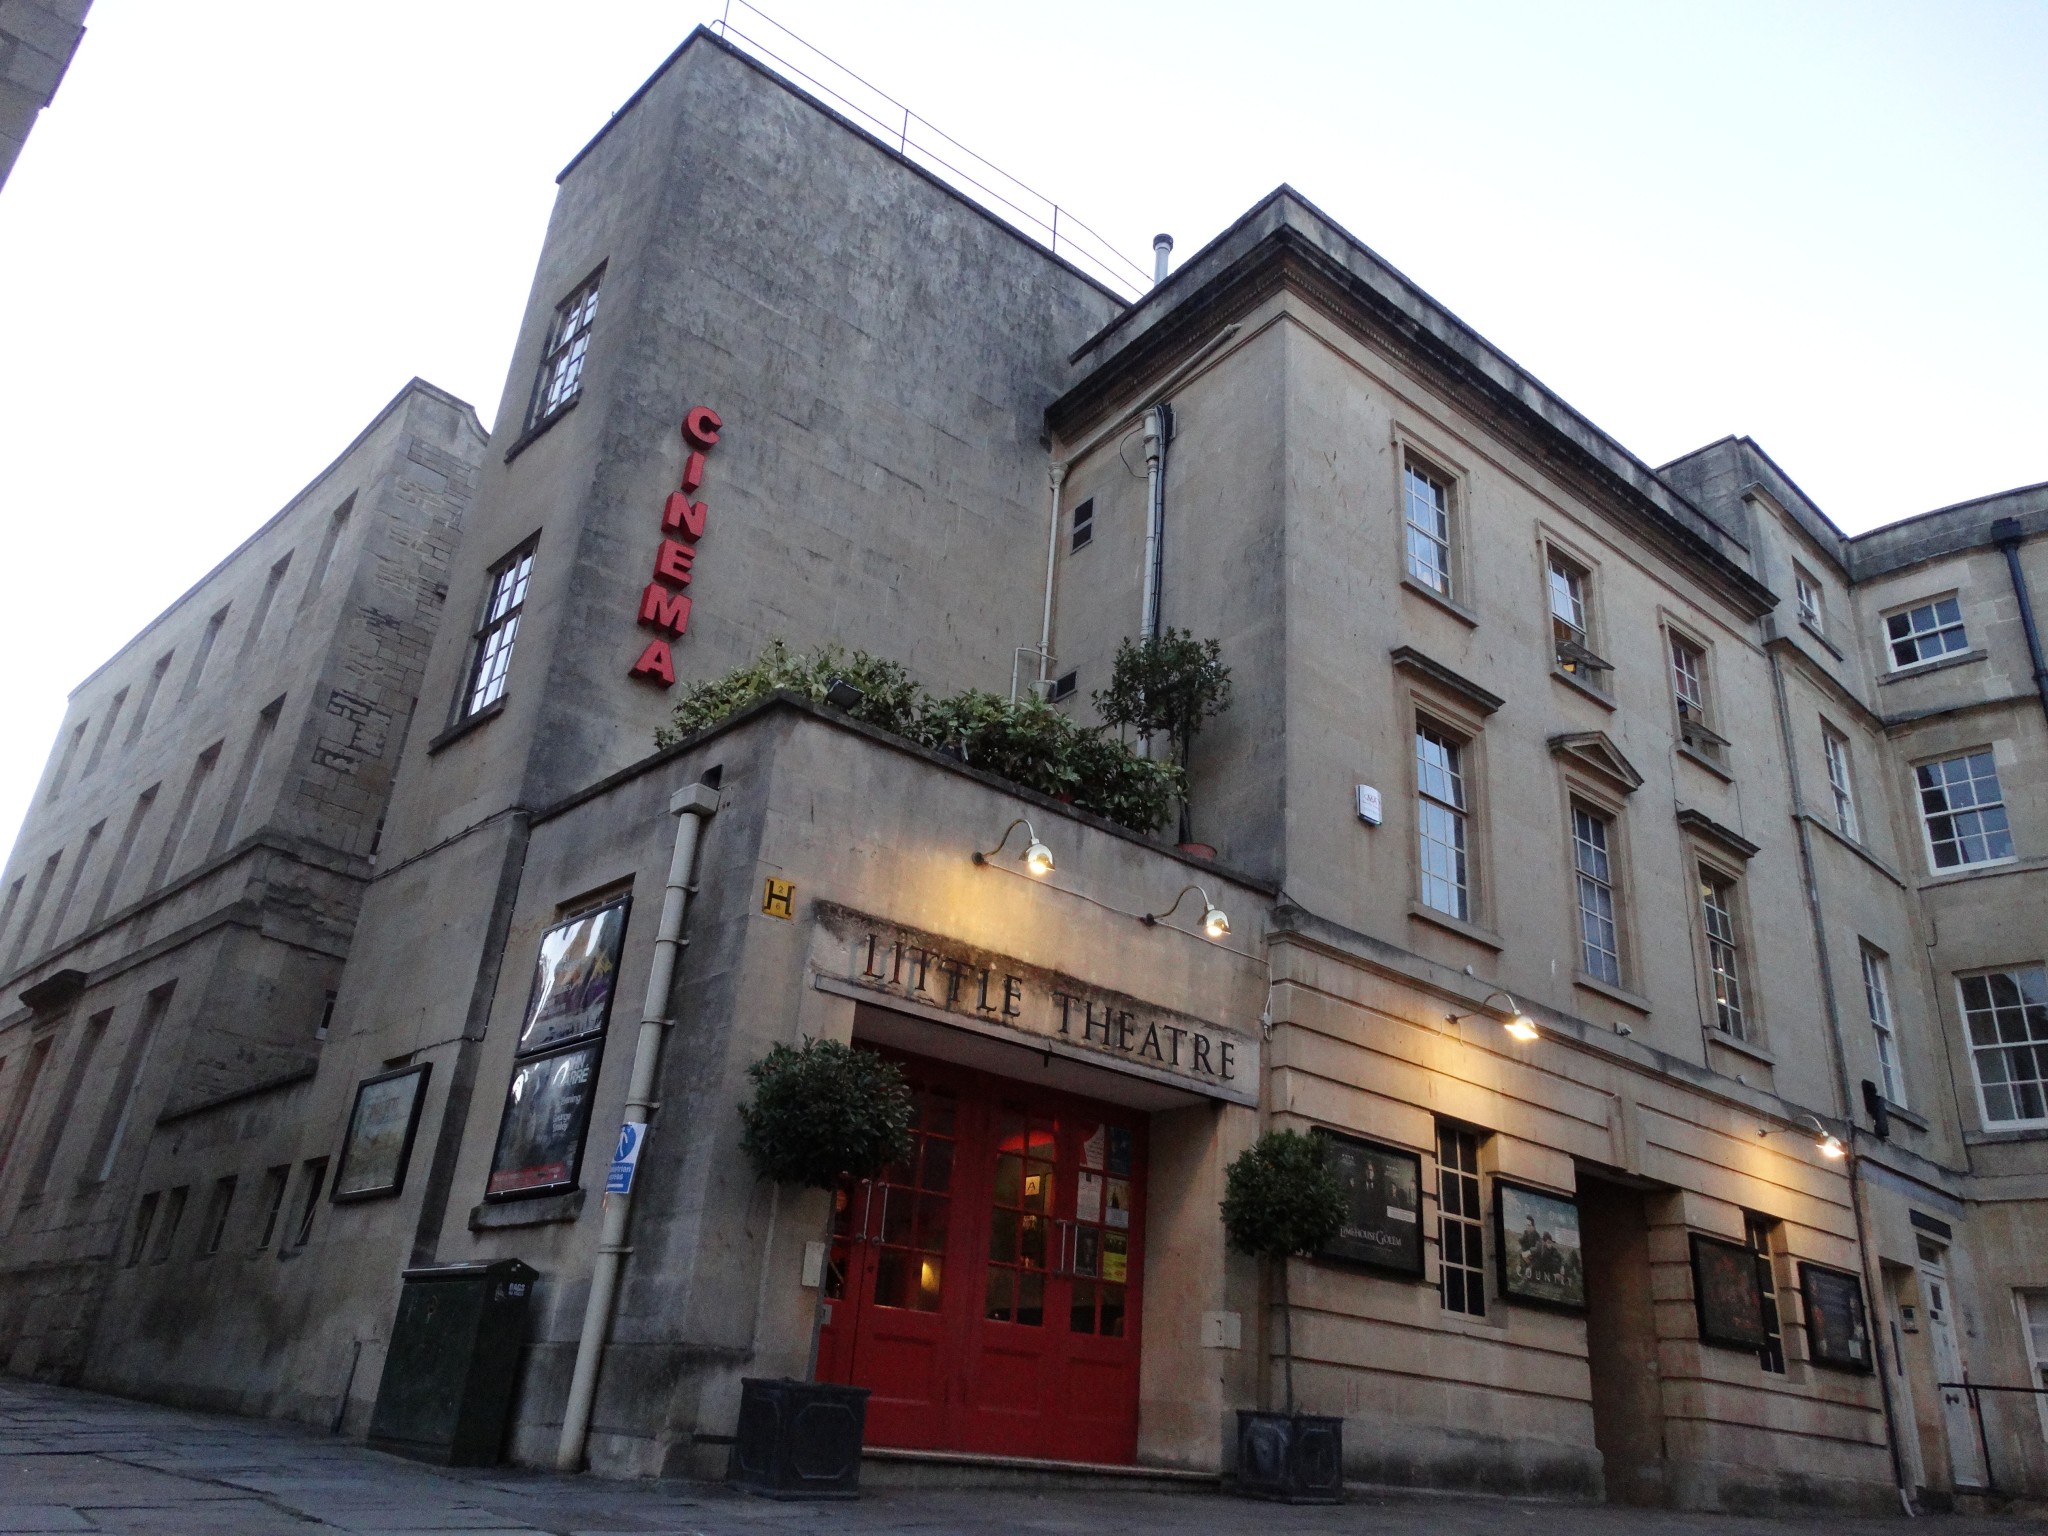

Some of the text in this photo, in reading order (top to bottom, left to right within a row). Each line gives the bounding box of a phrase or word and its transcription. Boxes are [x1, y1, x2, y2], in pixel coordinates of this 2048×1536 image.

[628, 405, 723, 690] CINEMA
[863, 932, 1236, 1080] LITTLE THEATRE
